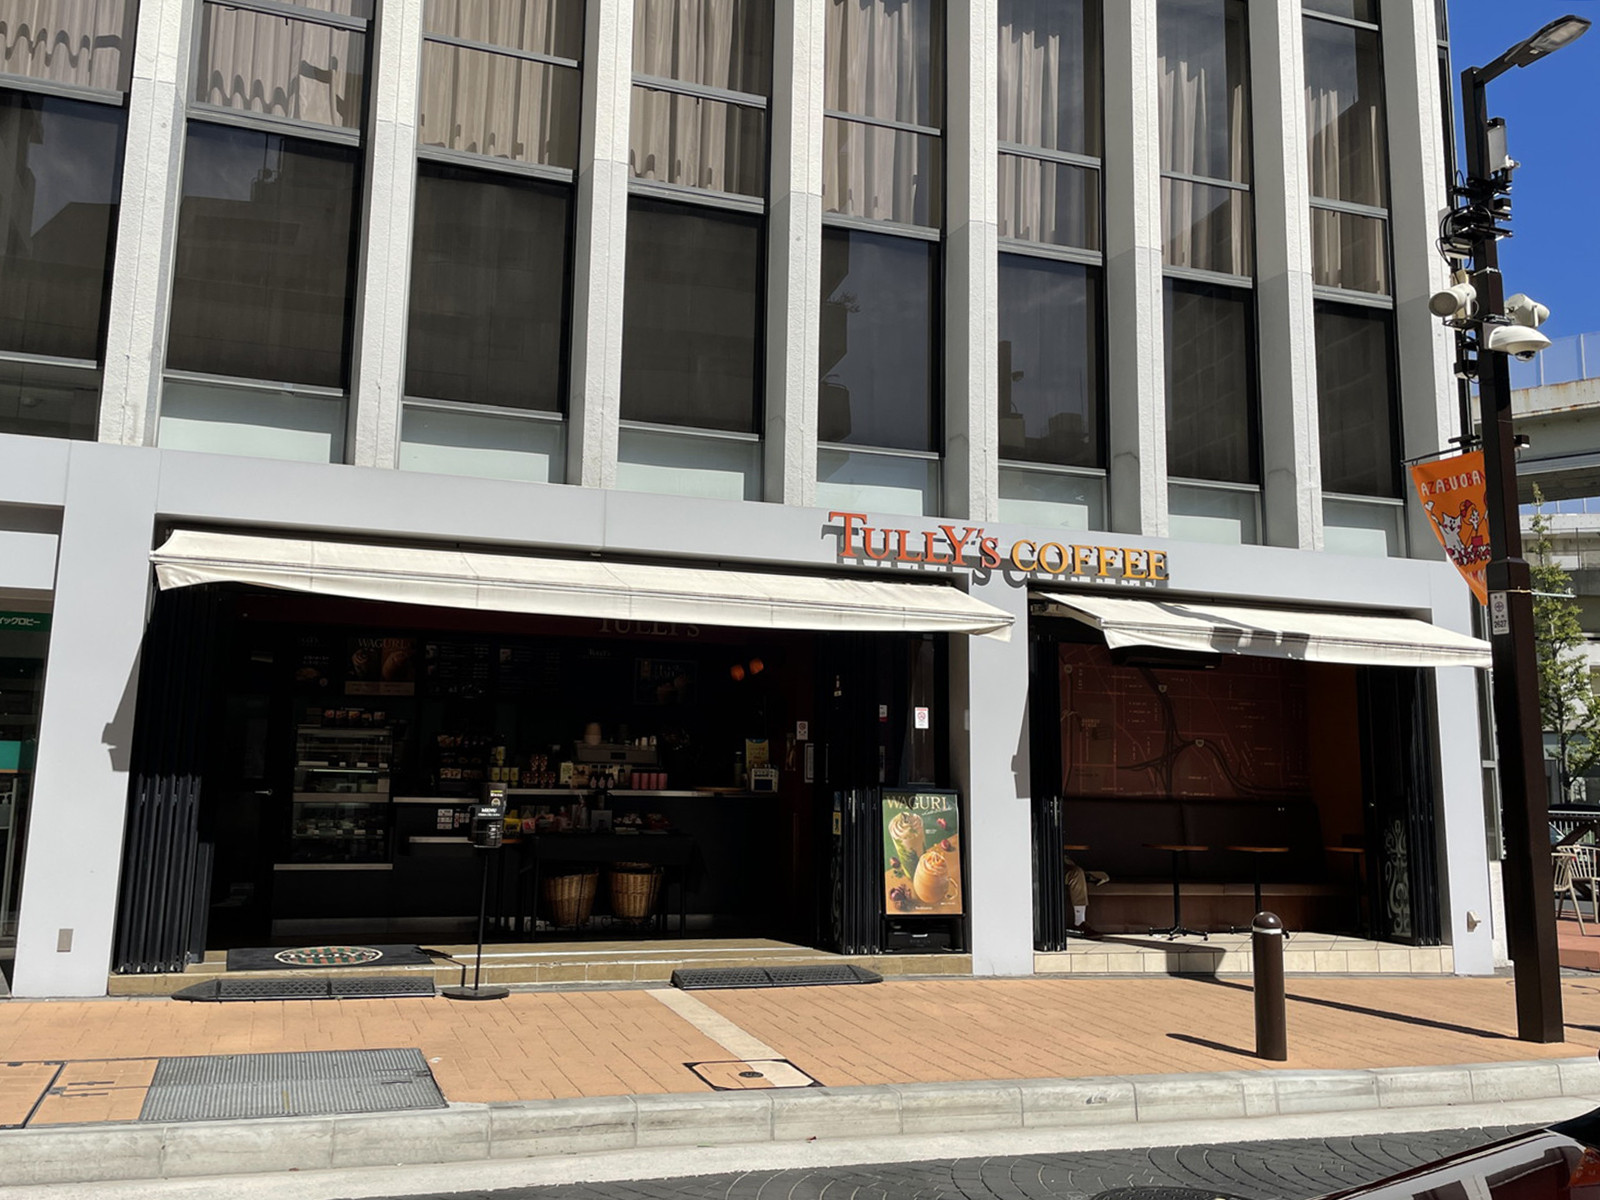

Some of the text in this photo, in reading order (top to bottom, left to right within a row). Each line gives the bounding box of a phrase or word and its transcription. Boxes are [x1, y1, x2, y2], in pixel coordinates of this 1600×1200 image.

[828, 511, 1169, 580] TULLY'S COFFEE
[886, 795, 948, 810] WAGURI
